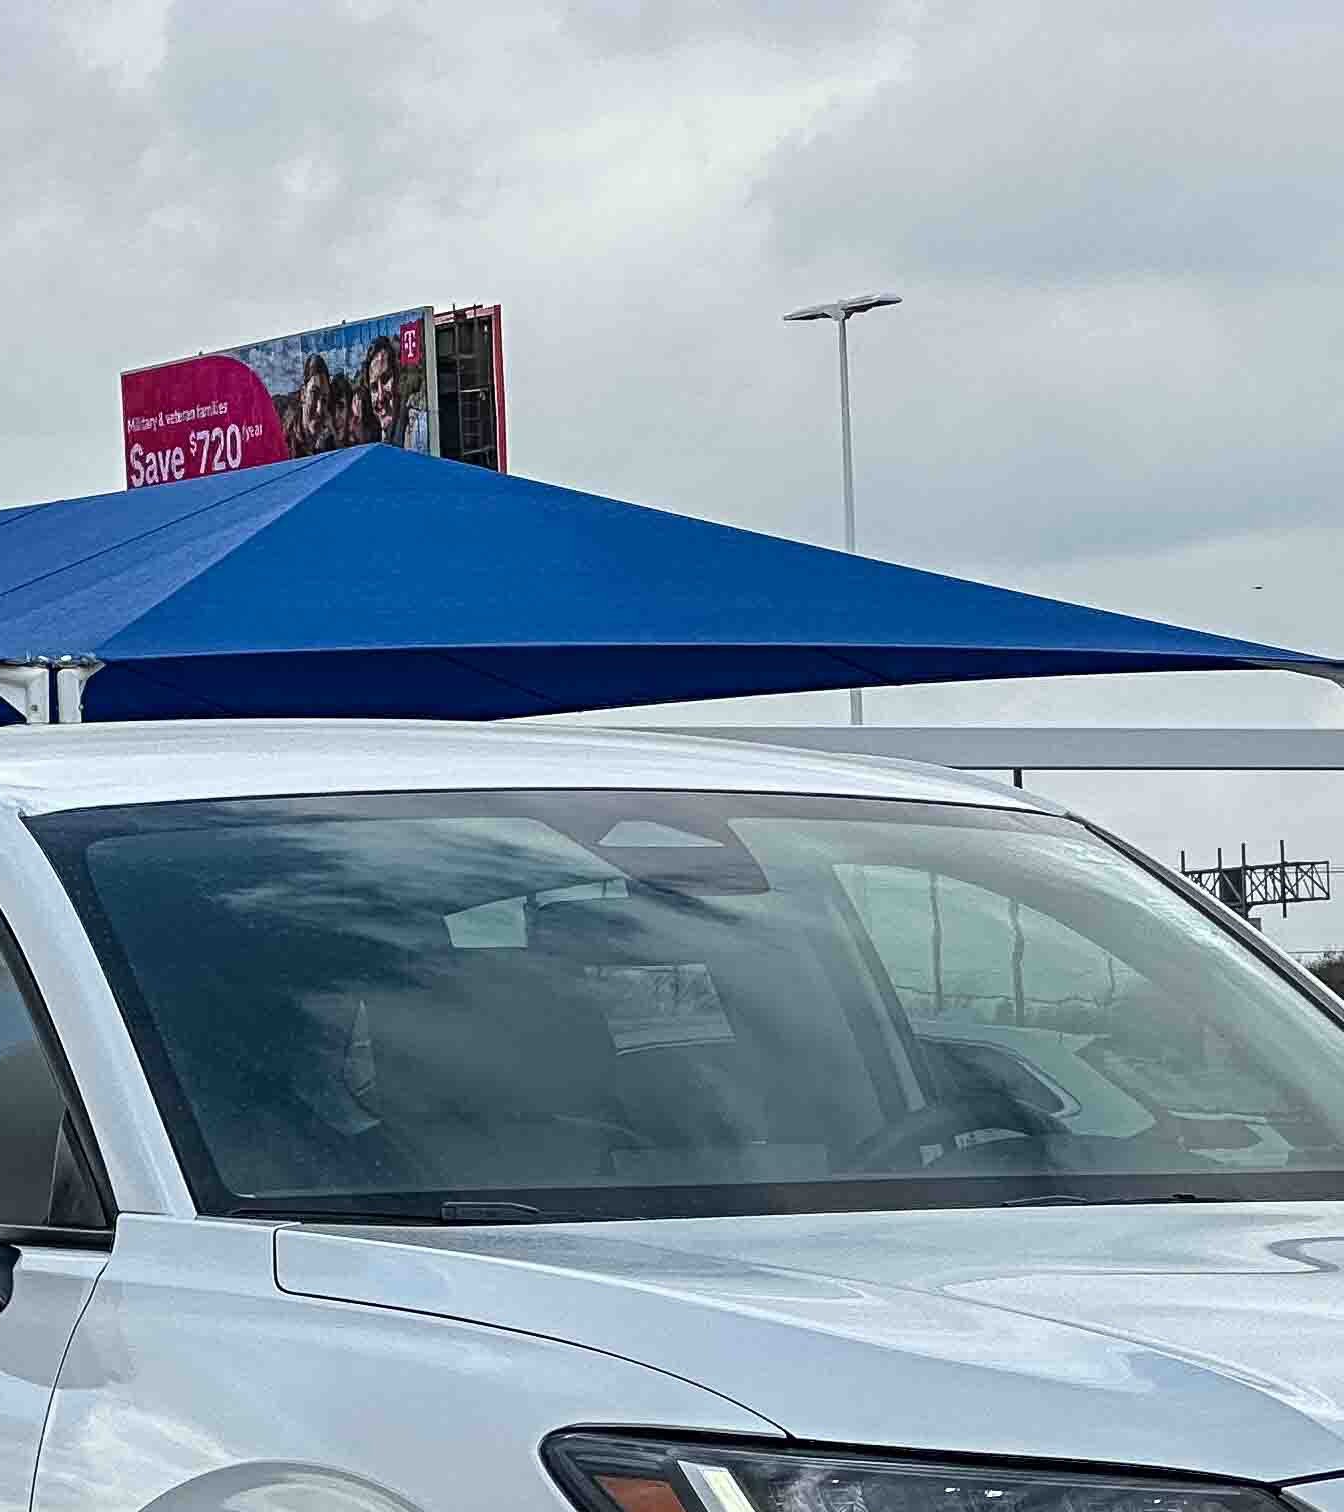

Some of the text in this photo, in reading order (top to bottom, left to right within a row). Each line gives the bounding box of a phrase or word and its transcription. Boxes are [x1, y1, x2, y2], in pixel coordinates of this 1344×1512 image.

[127, 415, 158, 433] Military
[196, 400, 229, 419] families
[129, 442, 185, 487] Save
